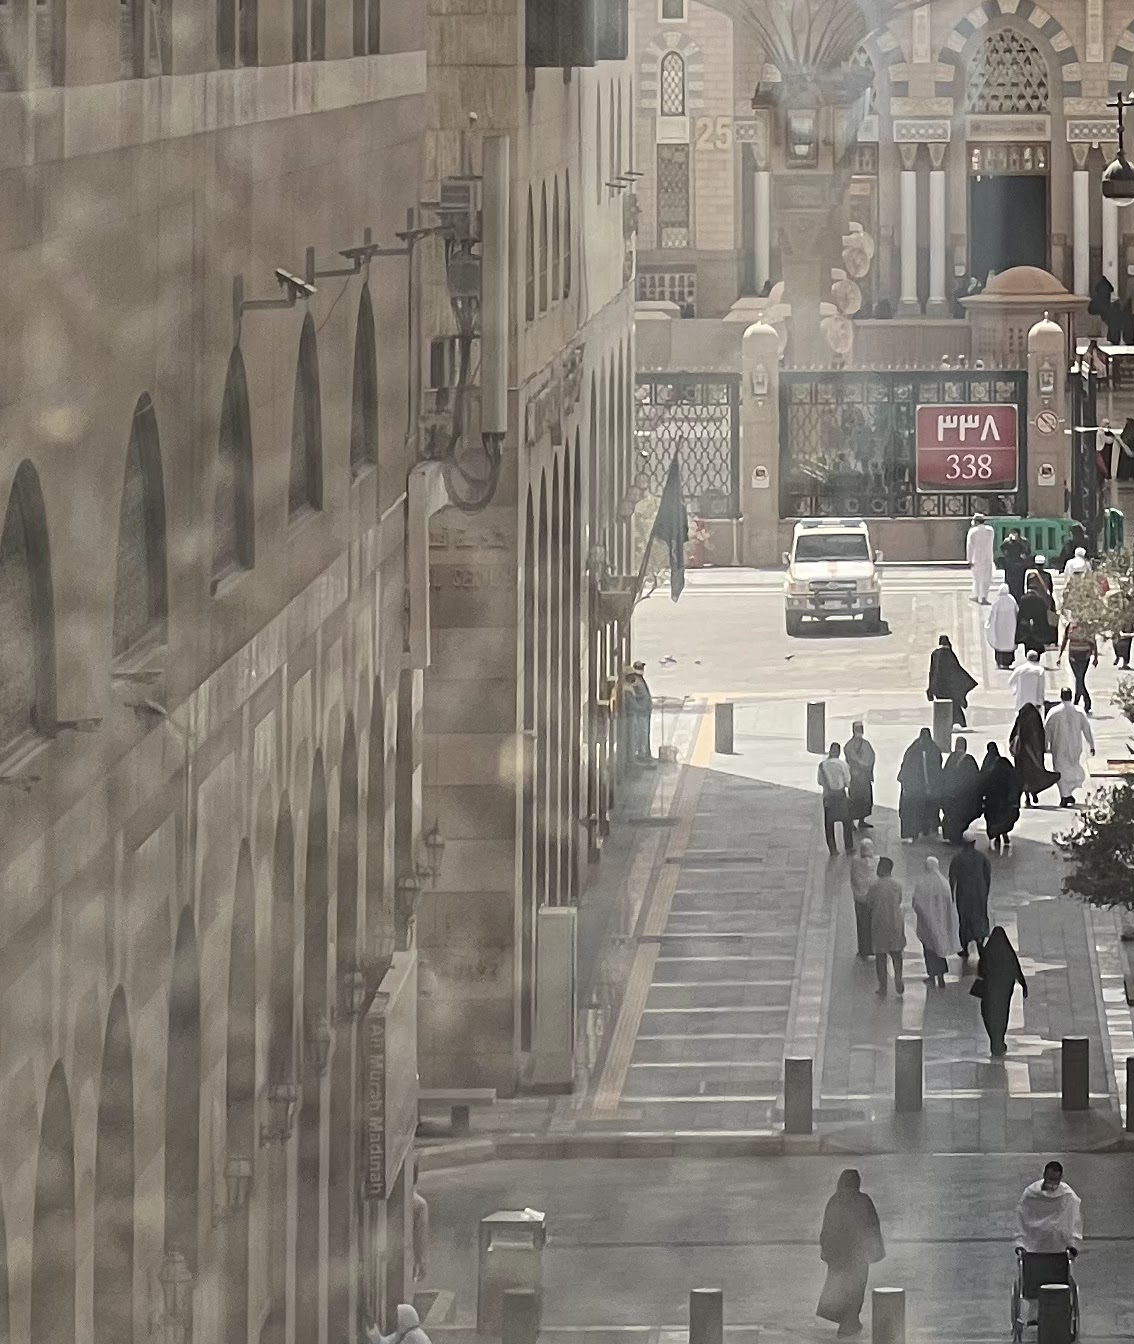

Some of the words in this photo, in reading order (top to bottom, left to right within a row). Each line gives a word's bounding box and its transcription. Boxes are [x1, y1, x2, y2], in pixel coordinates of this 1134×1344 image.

[694, 117, 732, 151] 25
[937, 414, 1000, 442] ٣٣٨
[945, 453, 992, 479] 338
